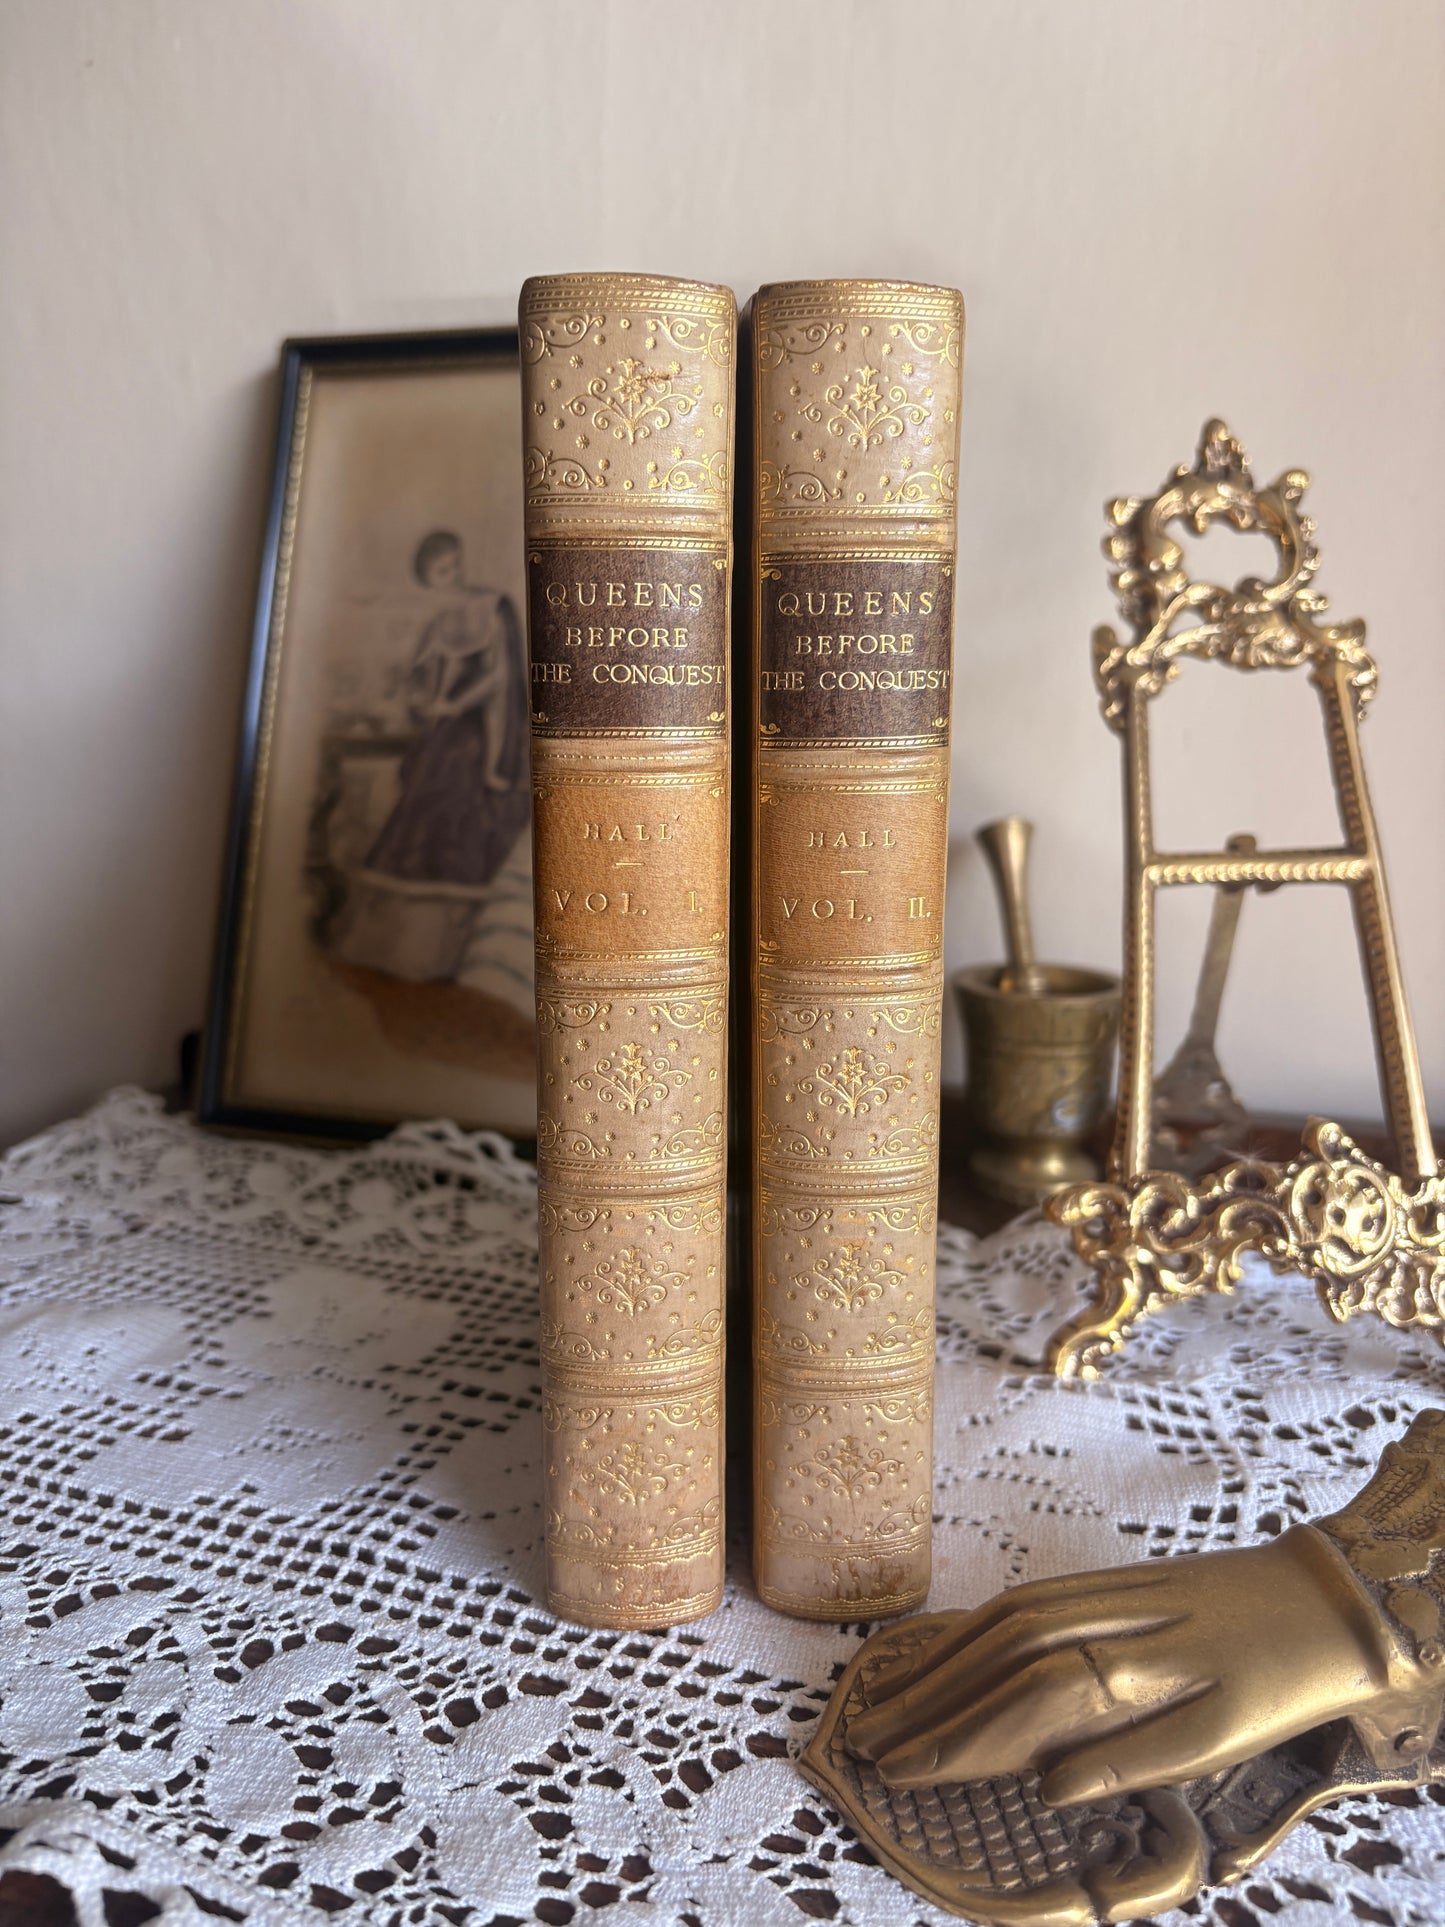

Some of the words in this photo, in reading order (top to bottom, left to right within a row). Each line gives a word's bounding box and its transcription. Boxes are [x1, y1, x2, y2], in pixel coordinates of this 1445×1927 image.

[546, 582, 703, 608] QUEENS
[778, 591, 933, 616] QUEENS
[565, 627, 689, 648] BEFORE
[796, 634, 915, 655] BEFORE
[531, 662, 572, 684] THE
[592, 663, 725, 686] CONQUEST
[762, 671, 805, 691] THE
[819, 670, 950, 691] CONQUEST
[583, 823, 673, 842] HALL
[808, 829, 897, 848] HALL
[551, 890, 649, 916] VOL.
[688, 890, 703, 913] I.
[779, 896, 873, 922] VOL.
[908, 897, 931, 919] II.
